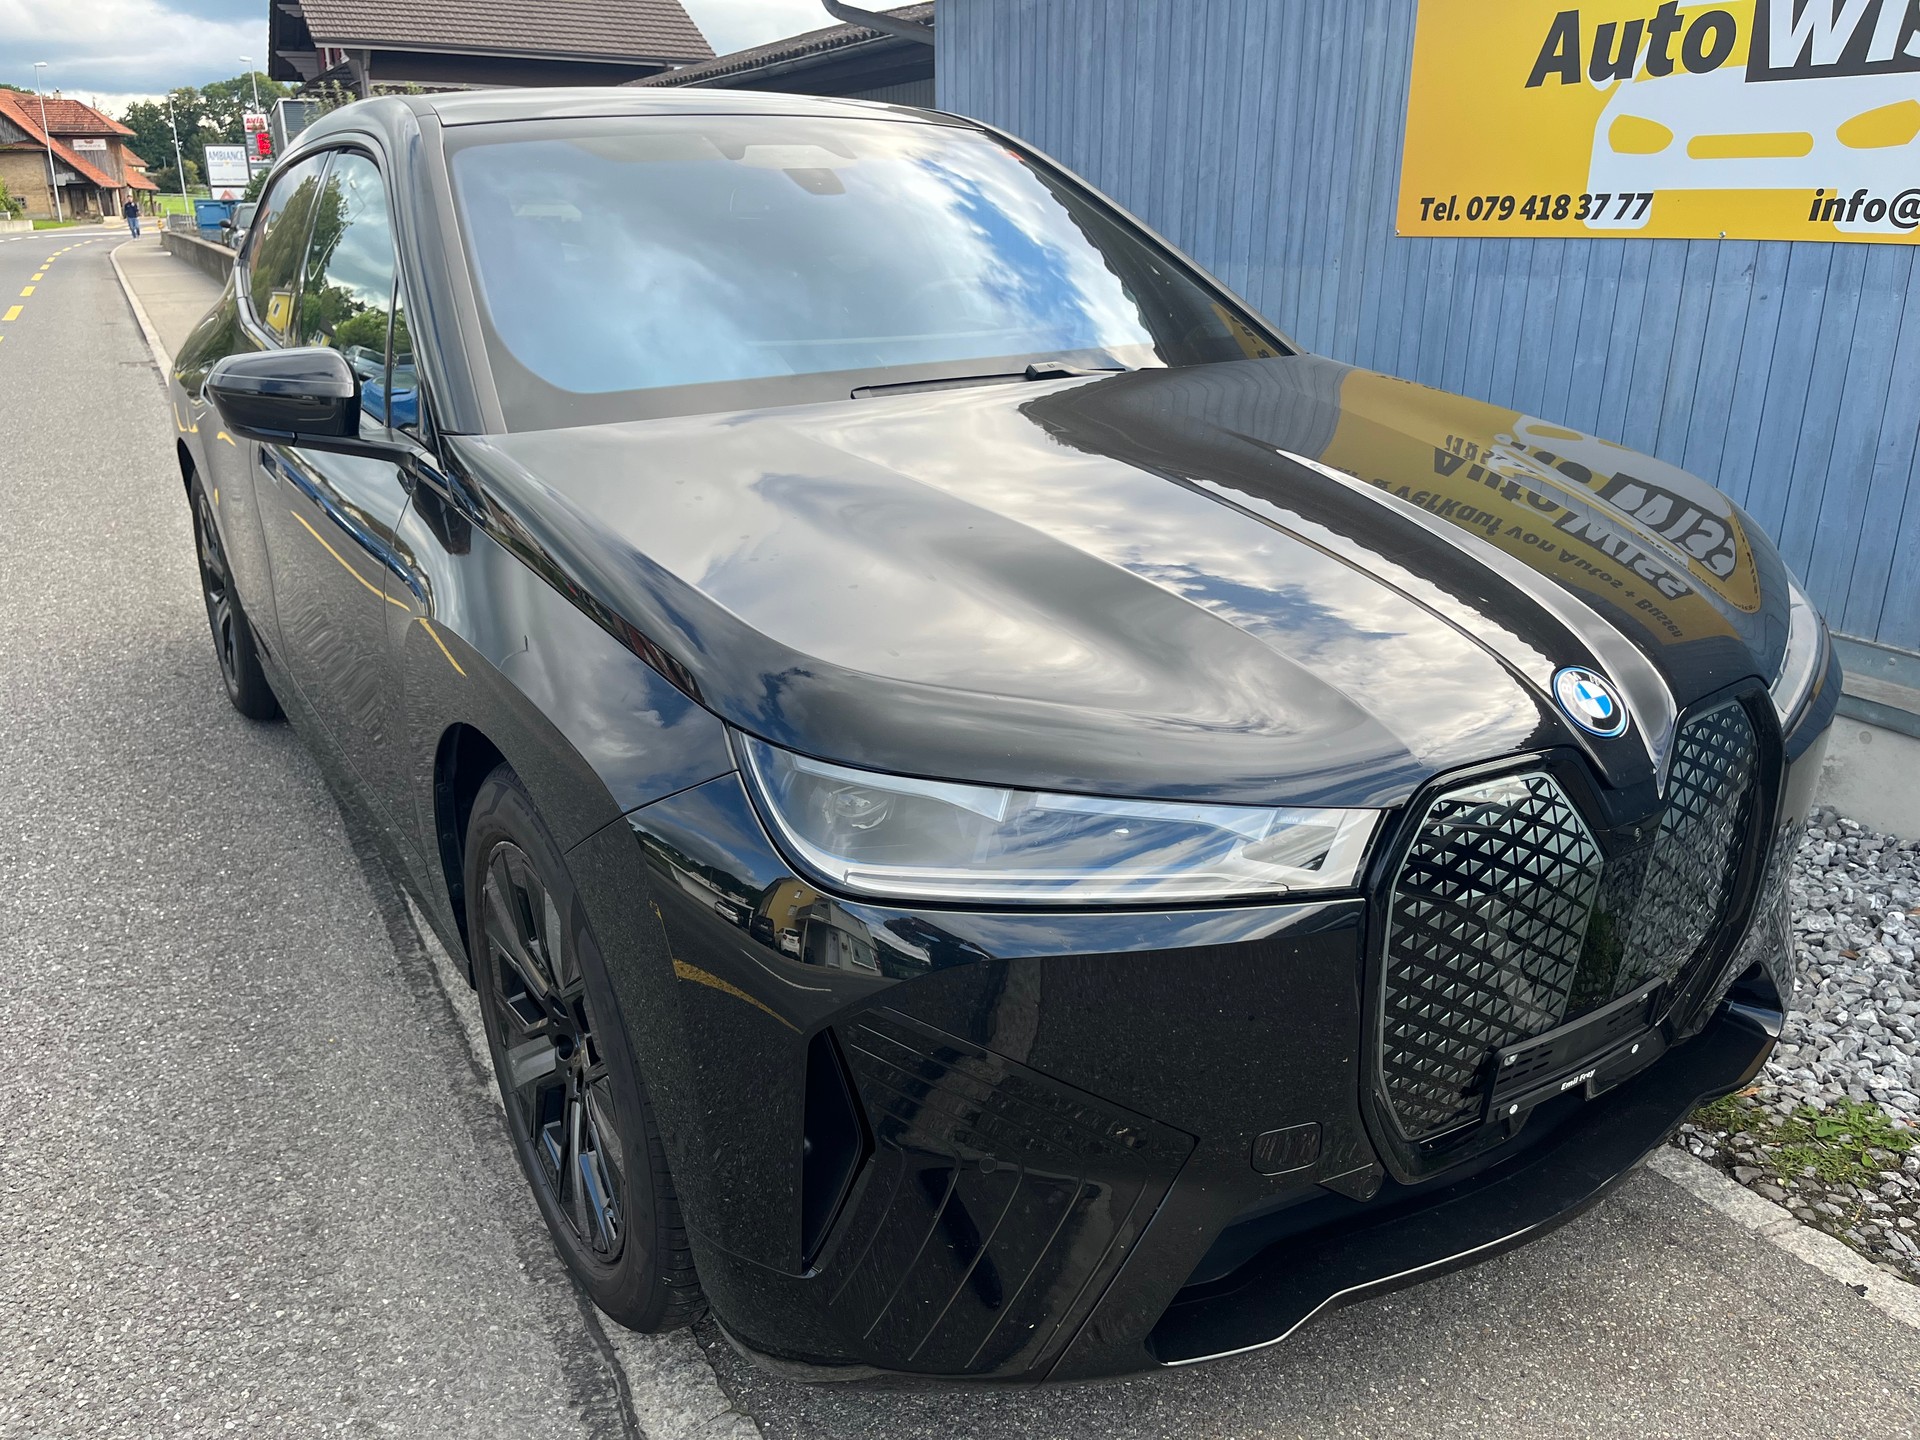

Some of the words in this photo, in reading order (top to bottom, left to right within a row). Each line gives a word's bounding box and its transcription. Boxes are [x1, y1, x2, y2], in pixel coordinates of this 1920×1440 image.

[1525, 0, 1737, 88] Auto
[1767, 0, 1920, 69] WI
[208, 151, 245, 161] AMBIANCE
[1420, 195, 1460, 221] Tel.
[1466, 195, 1516, 221] 079
[1519, 194, 1571, 220] 418
[1574, 193, 1612, 220] 37
[1614, 193, 1655, 220] 77
[1560, 1076, 1579, 1091] Emil
[1579, 1069, 1596, 1082] Frey
